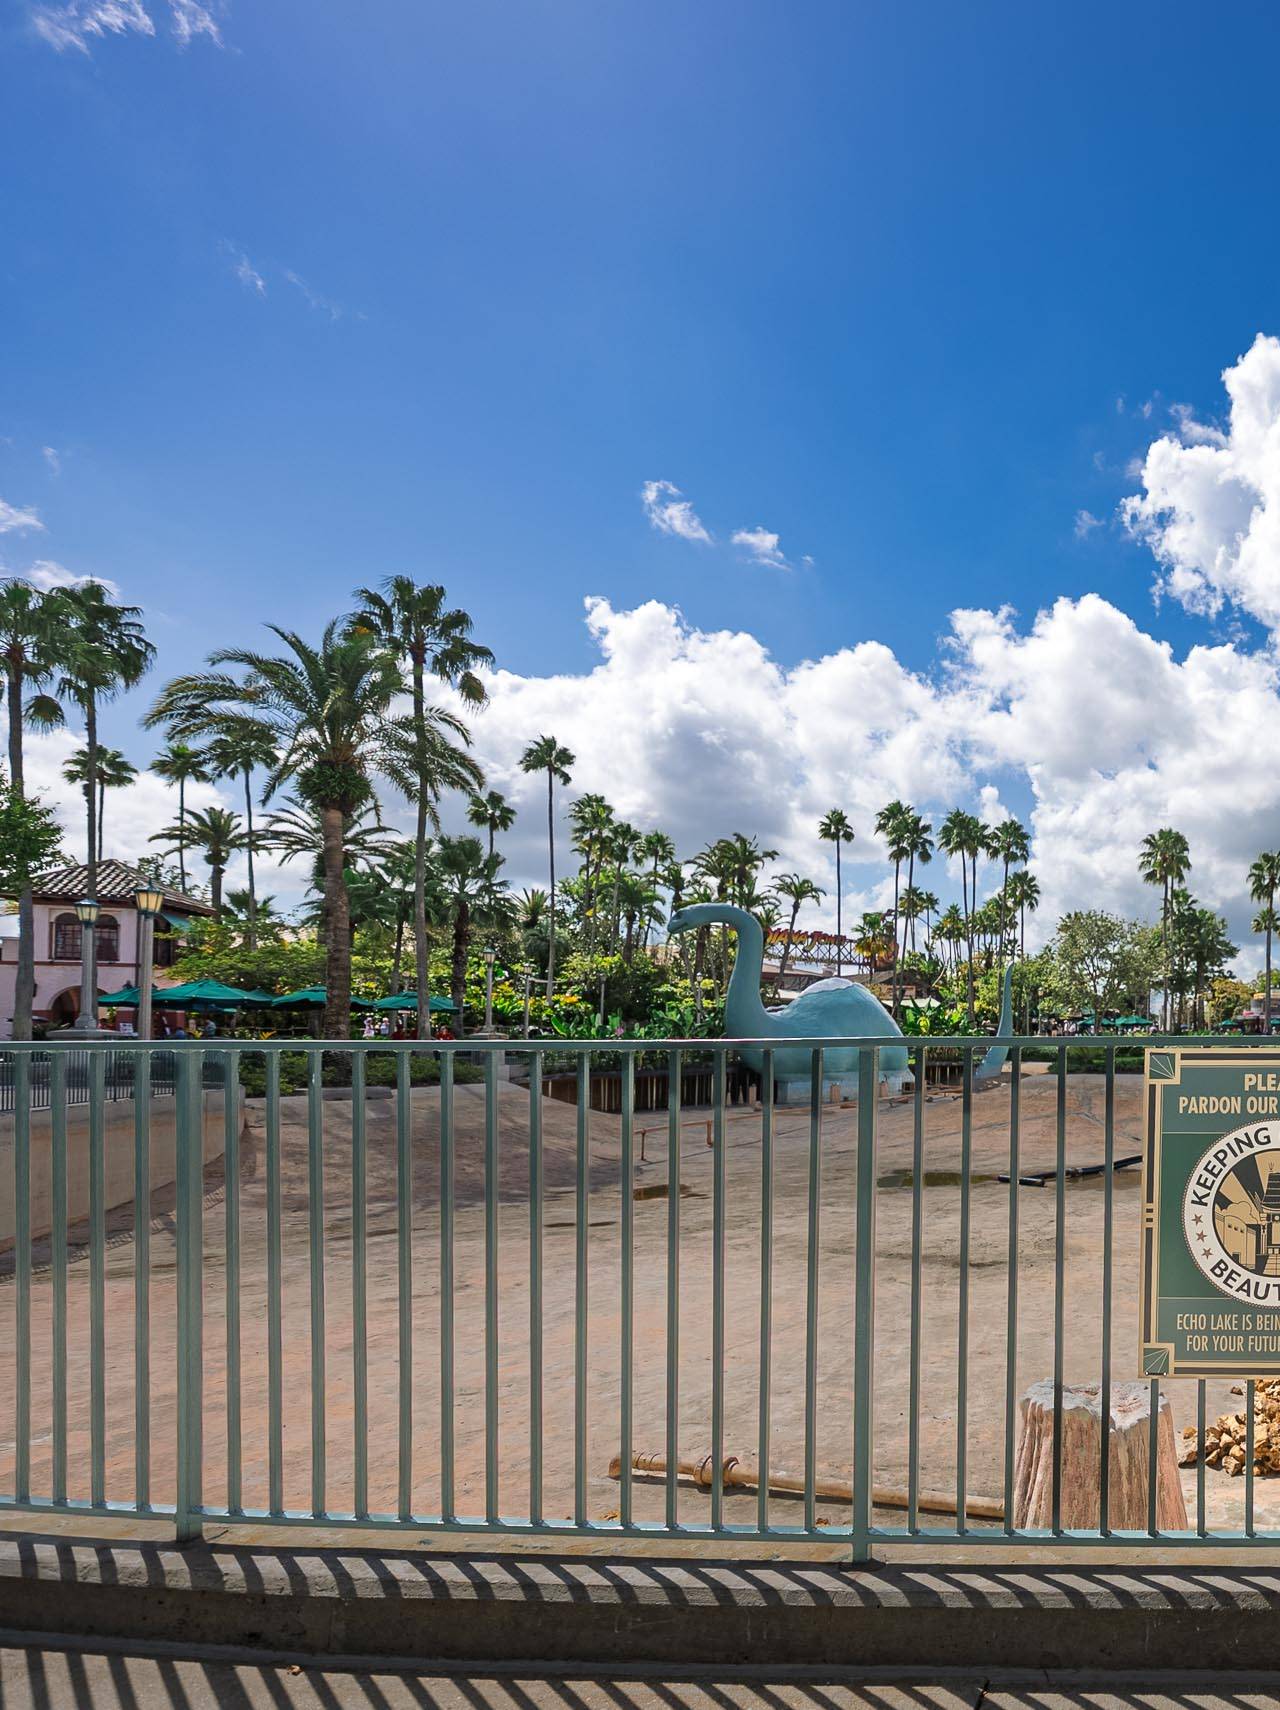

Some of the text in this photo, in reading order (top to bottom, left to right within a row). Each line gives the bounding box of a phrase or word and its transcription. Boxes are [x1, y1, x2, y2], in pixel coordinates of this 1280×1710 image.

[1178, 1096, 1241, 1114] PARDON
[1246, 1096, 1278, 1114] OUR
[1191, 1127, 1272, 1207] KEEPING
[1176, 1314, 1206, 1331] ECHO
[1211, 1314, 1238, 1330] LAKE
[1242, 1314, 1252, 1330] IS
[1186, 1335, 1208, 1352] FOR
[1212, 1335, 1244, 1352] YOUR
